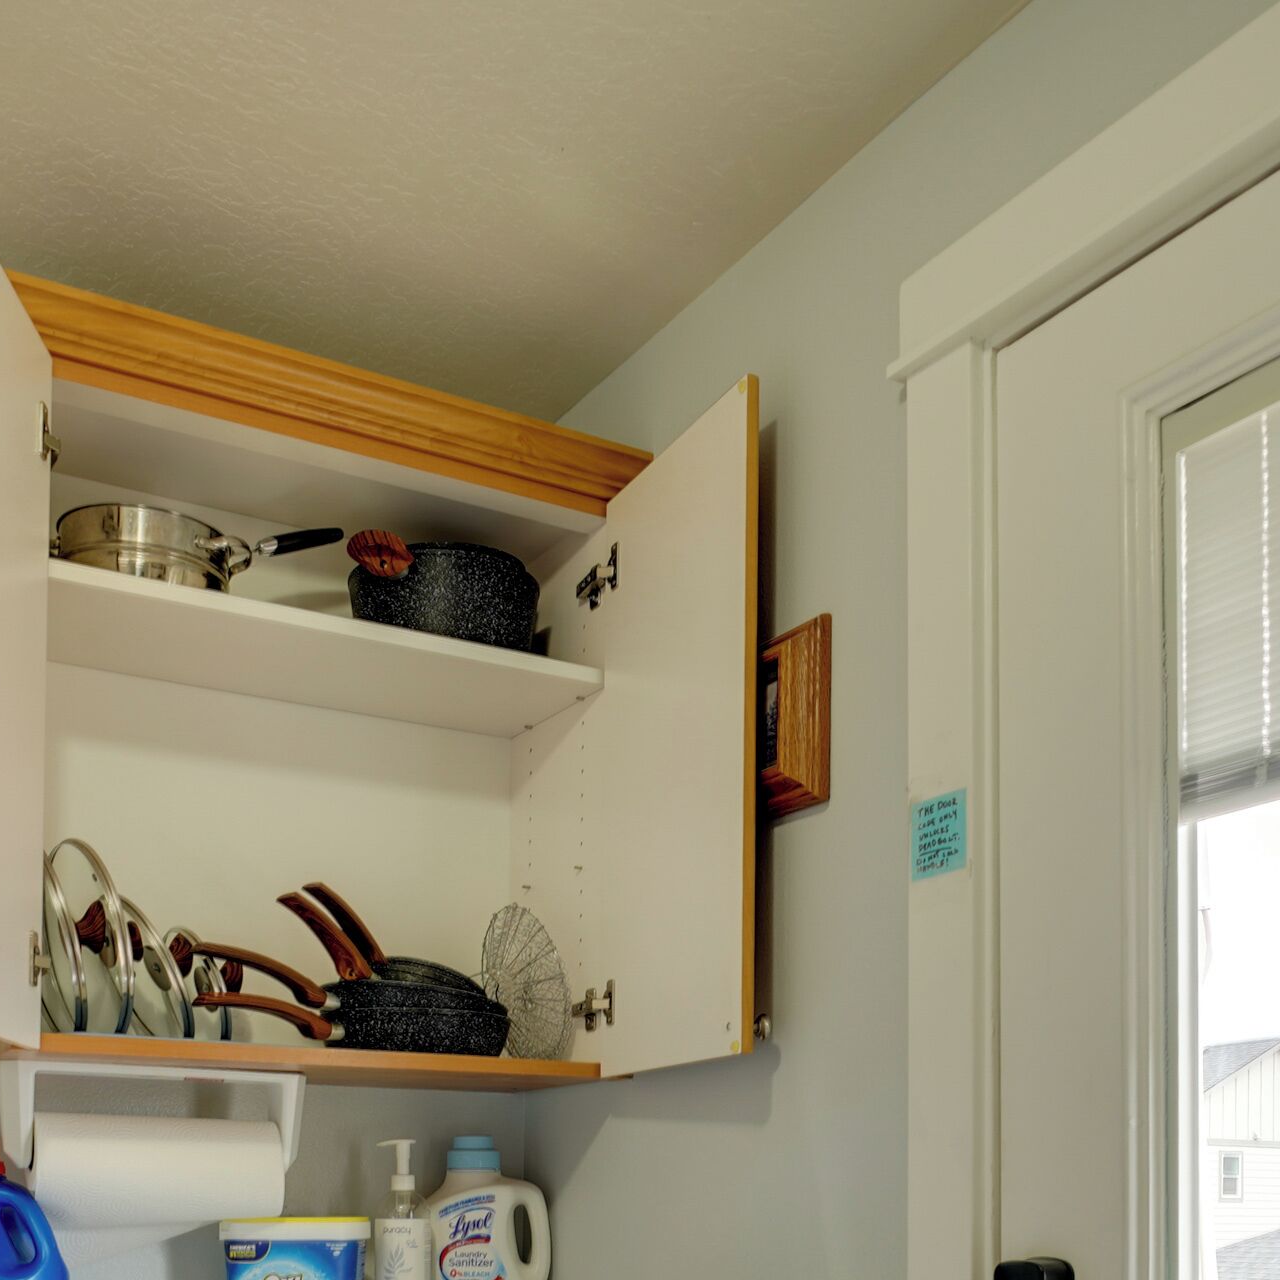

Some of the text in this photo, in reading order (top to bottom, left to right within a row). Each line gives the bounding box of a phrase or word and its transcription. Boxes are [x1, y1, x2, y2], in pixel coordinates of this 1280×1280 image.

[918, 797, 958, 818] THE DOOR
[939, 808, 958, 823] ONLY
[449, 1211, 493, 1239] Lysol
[454, 1250, 488, 1259] Laundry
[448, 1258, 494, 1267] Sanitizer
